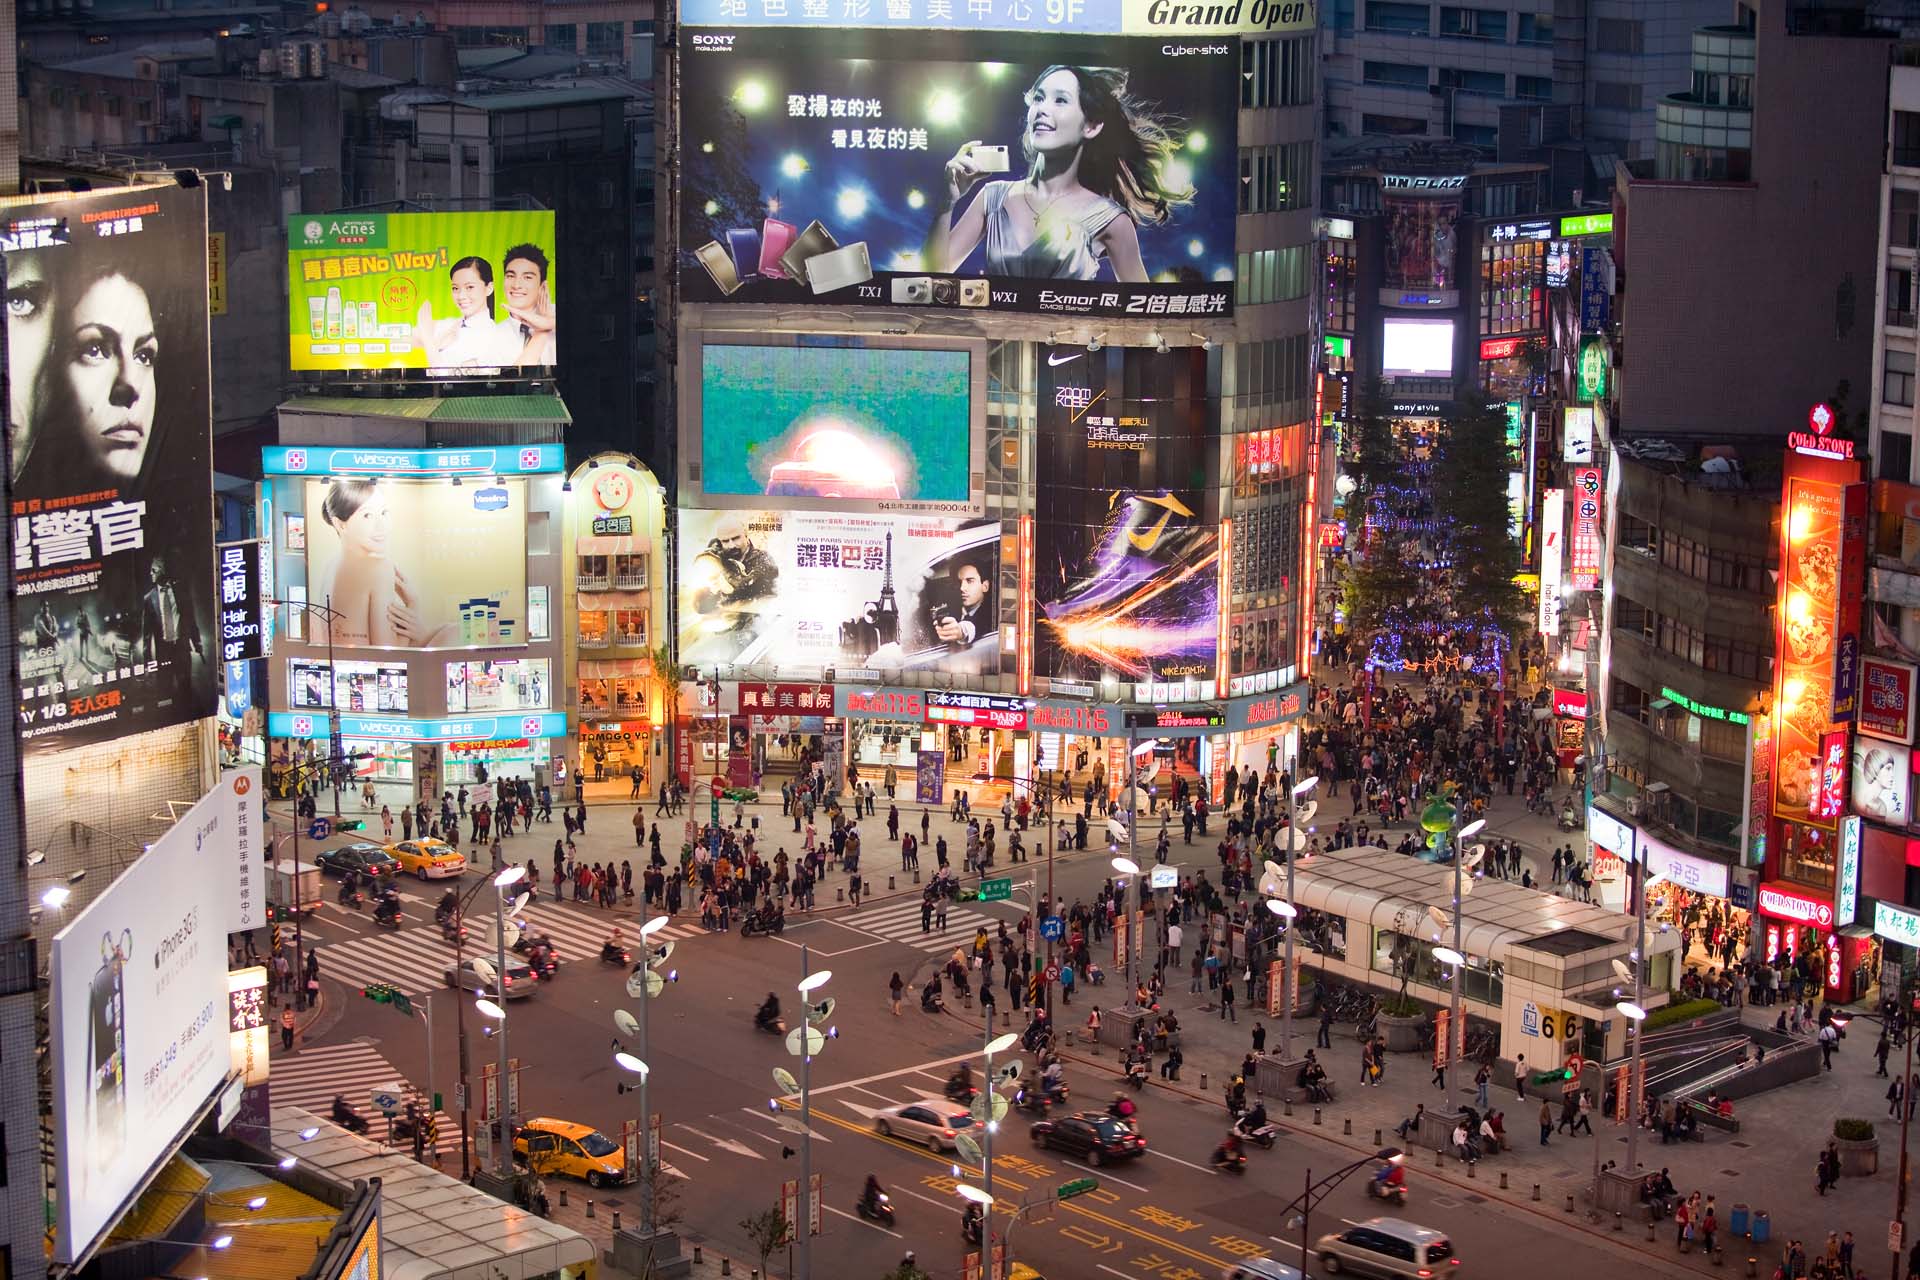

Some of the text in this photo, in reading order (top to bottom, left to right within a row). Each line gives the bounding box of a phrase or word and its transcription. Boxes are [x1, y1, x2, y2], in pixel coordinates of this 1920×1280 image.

[1047, 0, 1084, 24] 9F
[1148, 0, 1304, 29] Grand Open
[692, 35, 736, 45] SONY
[1162, 44, 1229, 56] Cyber-shot
[788, 94, 882, 118] 發揚夜的光
[832, 127, 928, 151] 看見夜的美
[329, 221, 376, 235] Acnes
[858, 286, 882, 298] TX1
[992, 291, 1017, 303] WX1
[1038, 291, 1098, 306] Exmor
[1126, 294, 1227, 313] 2倍高感光
[1394, 403, 1440, 414] sony style
[1788, 431, 1854, 458] COLD STONE
[1821, 506, 1840, 516] Crea
[797, 544, 884, 570] 諜戰巴黎
[1544, 584, 1555, 626] hair salon
[223, 610, 247, 624] Hair
[223, 624, 259, 639] Salon
[798, 621, 823, 631] 2/5
[224, 642, 245, 659] 9F
[1161, 666, 1206, 676] NIKE.COM.TW
[743, 691, 832, 709] 真善美劇院
[41, 703, 67, 719] 1/8
[989, 711, 1024, 723] DAISO
[581, 732, 649, 741] TAMAGO YA
[1759, 890, 1784, 907] COLD
[1785, 897, 1817, 919] STONE
[1542, 1016, 1554, 1038] 6
[1565, 1016, 1577, 1038] 6
